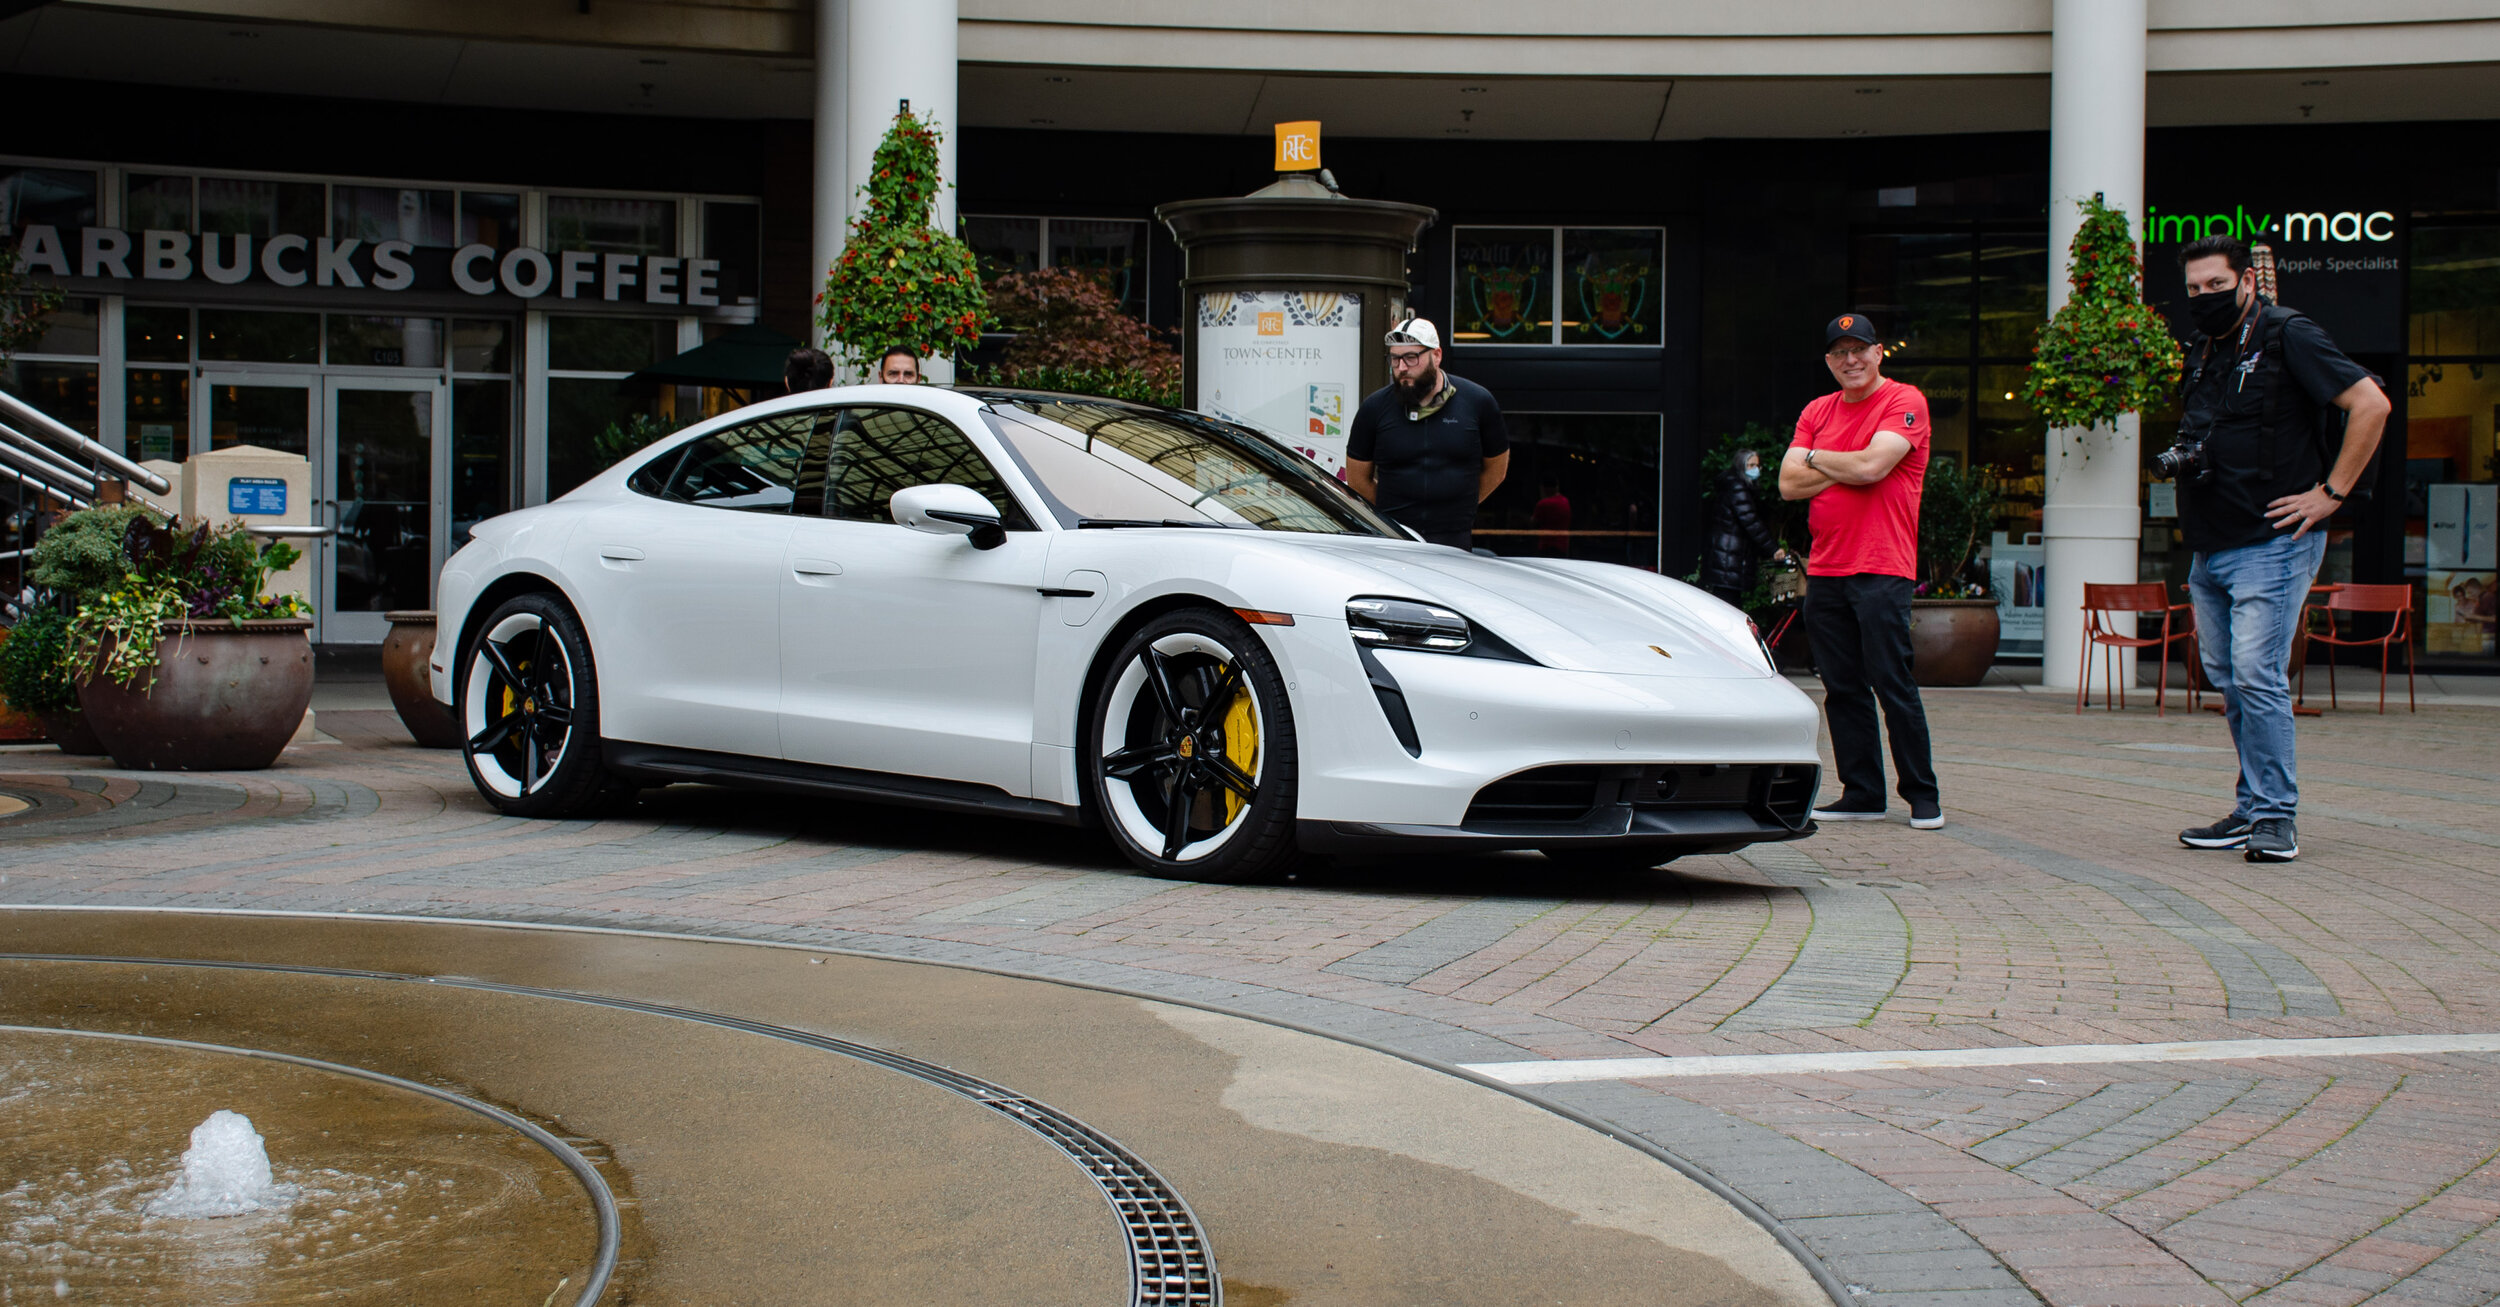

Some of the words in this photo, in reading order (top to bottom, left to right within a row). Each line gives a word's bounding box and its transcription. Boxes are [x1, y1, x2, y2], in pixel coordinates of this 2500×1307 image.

[1282, 134, 1314, 162] RTC
[451, 244, 721, 306] COFFEE
[2277, 257, 2321, 273] Apple
[2326, 256, 2399, 273] Specialist
[1223, 347, 1262, 360] TOWN
[1266, 347, 1322, 360] CENTER
